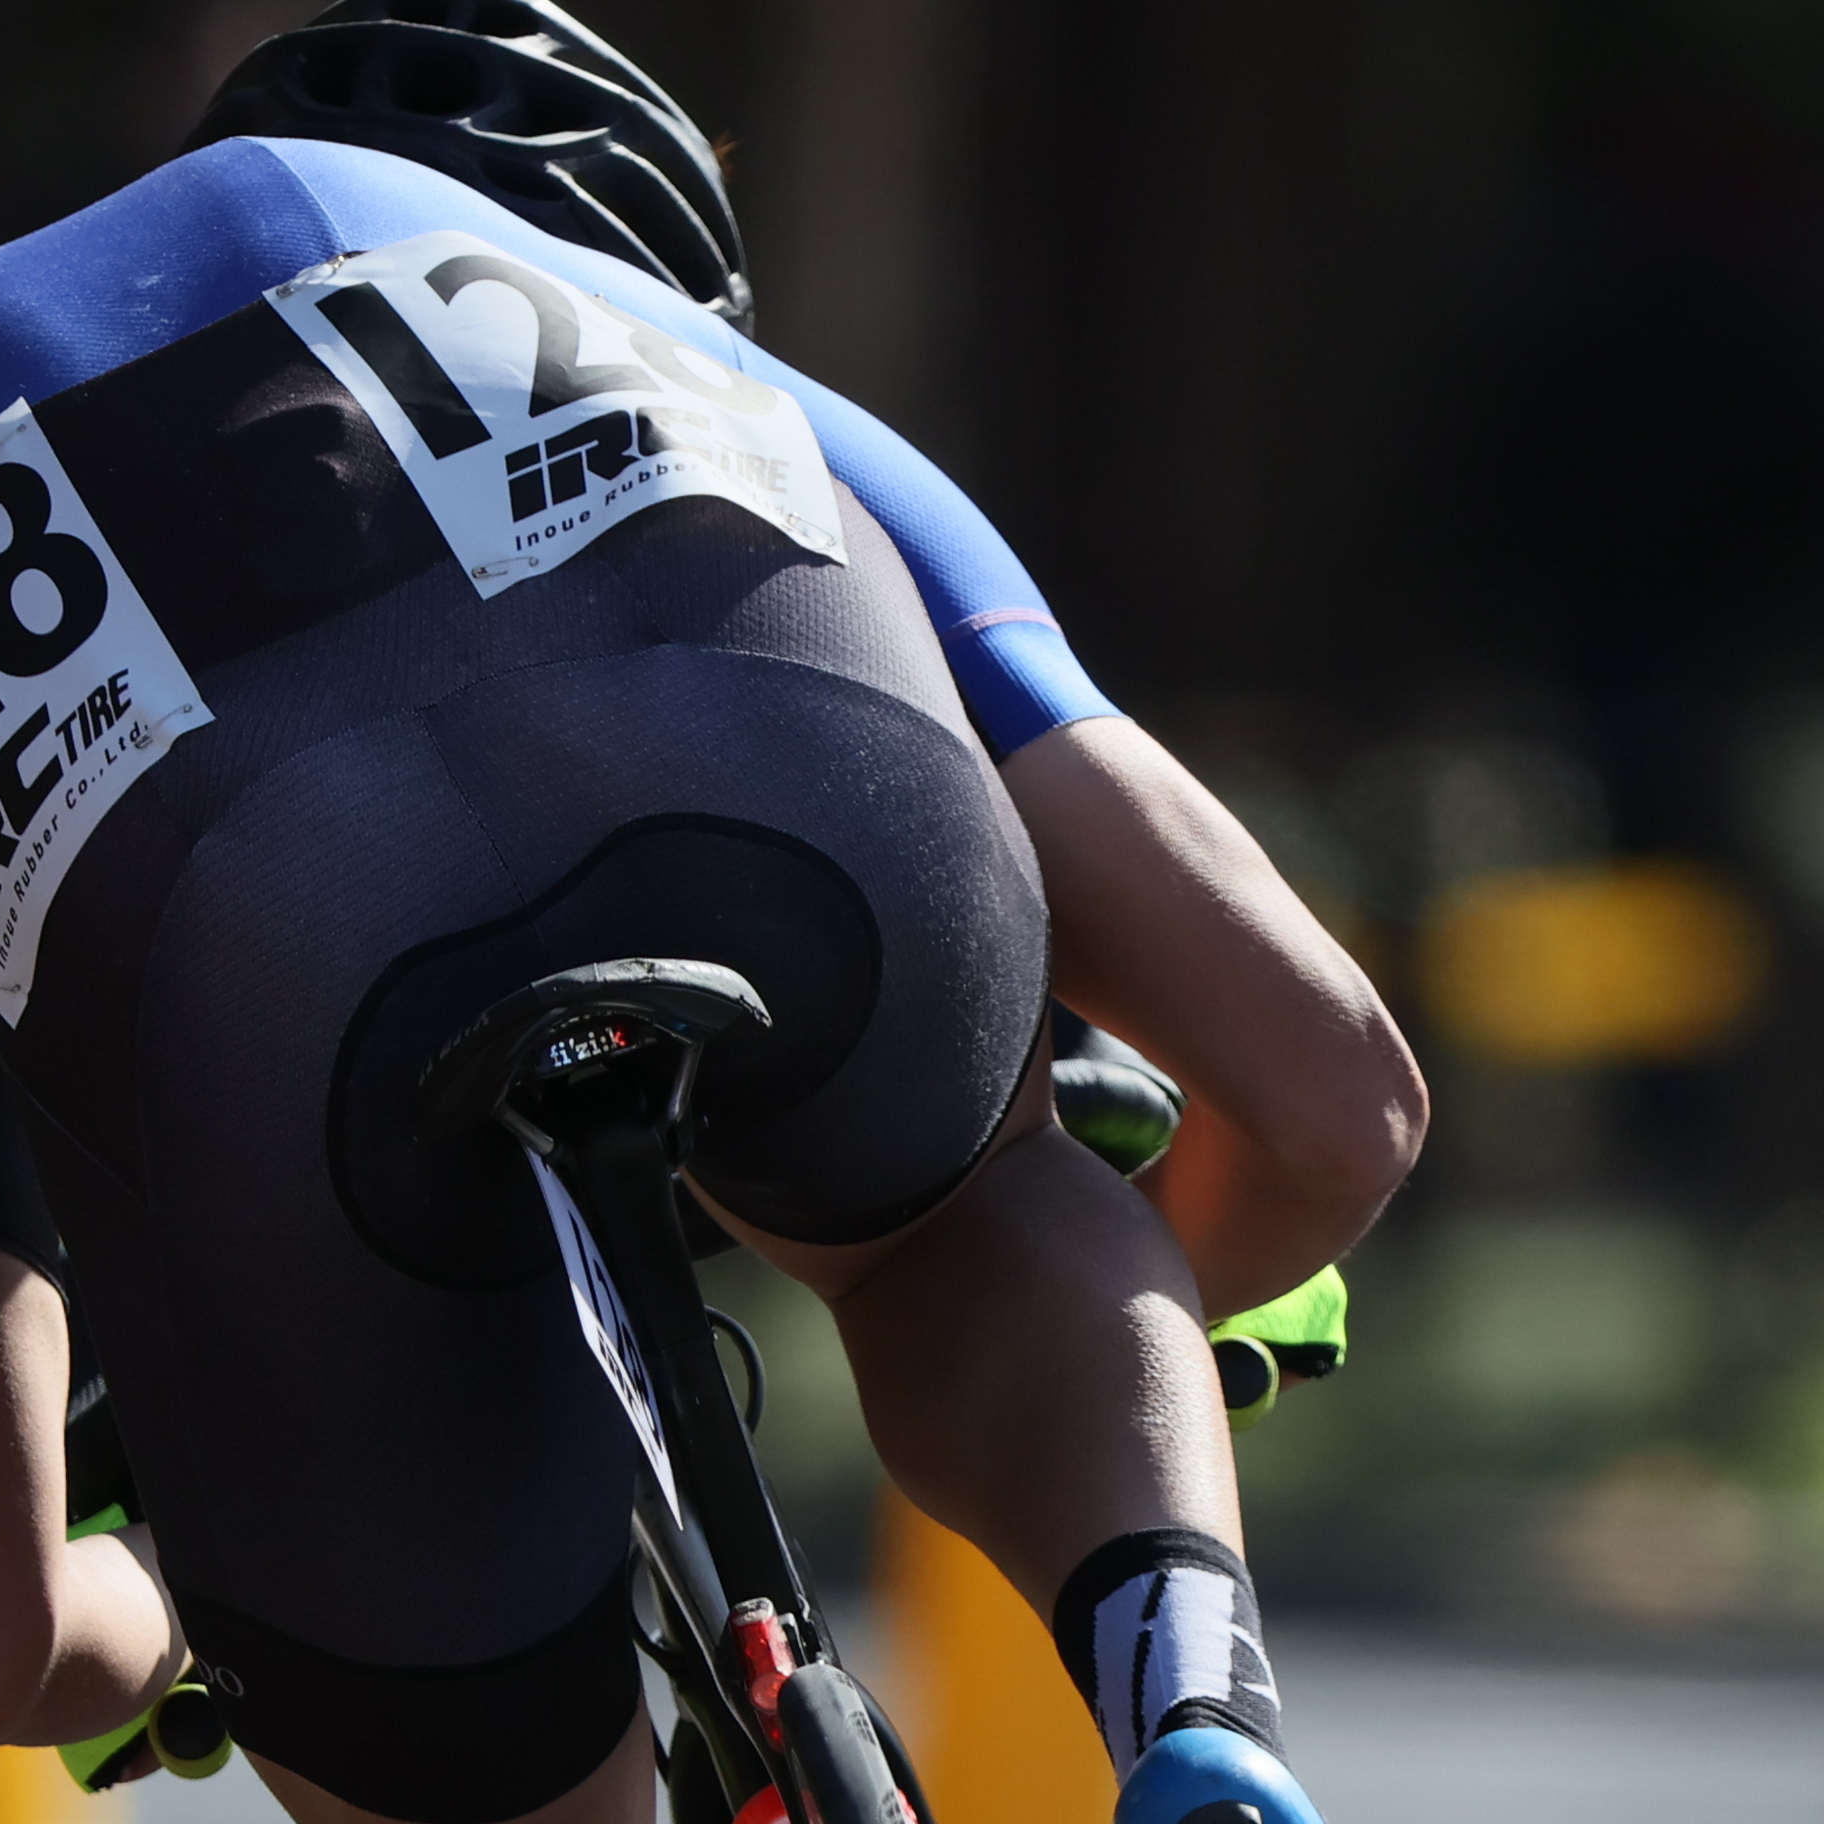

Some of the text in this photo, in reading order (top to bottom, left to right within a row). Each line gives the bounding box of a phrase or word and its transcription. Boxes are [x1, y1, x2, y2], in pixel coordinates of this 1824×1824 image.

[515, 510, 591, 551] Inoue
[604, 463, 699, 506] Rubber
[714, 439, 790, 494] TIRE
[54, 668, 132, 766] TIRE
[14, 814, 59, 902] Rubber
